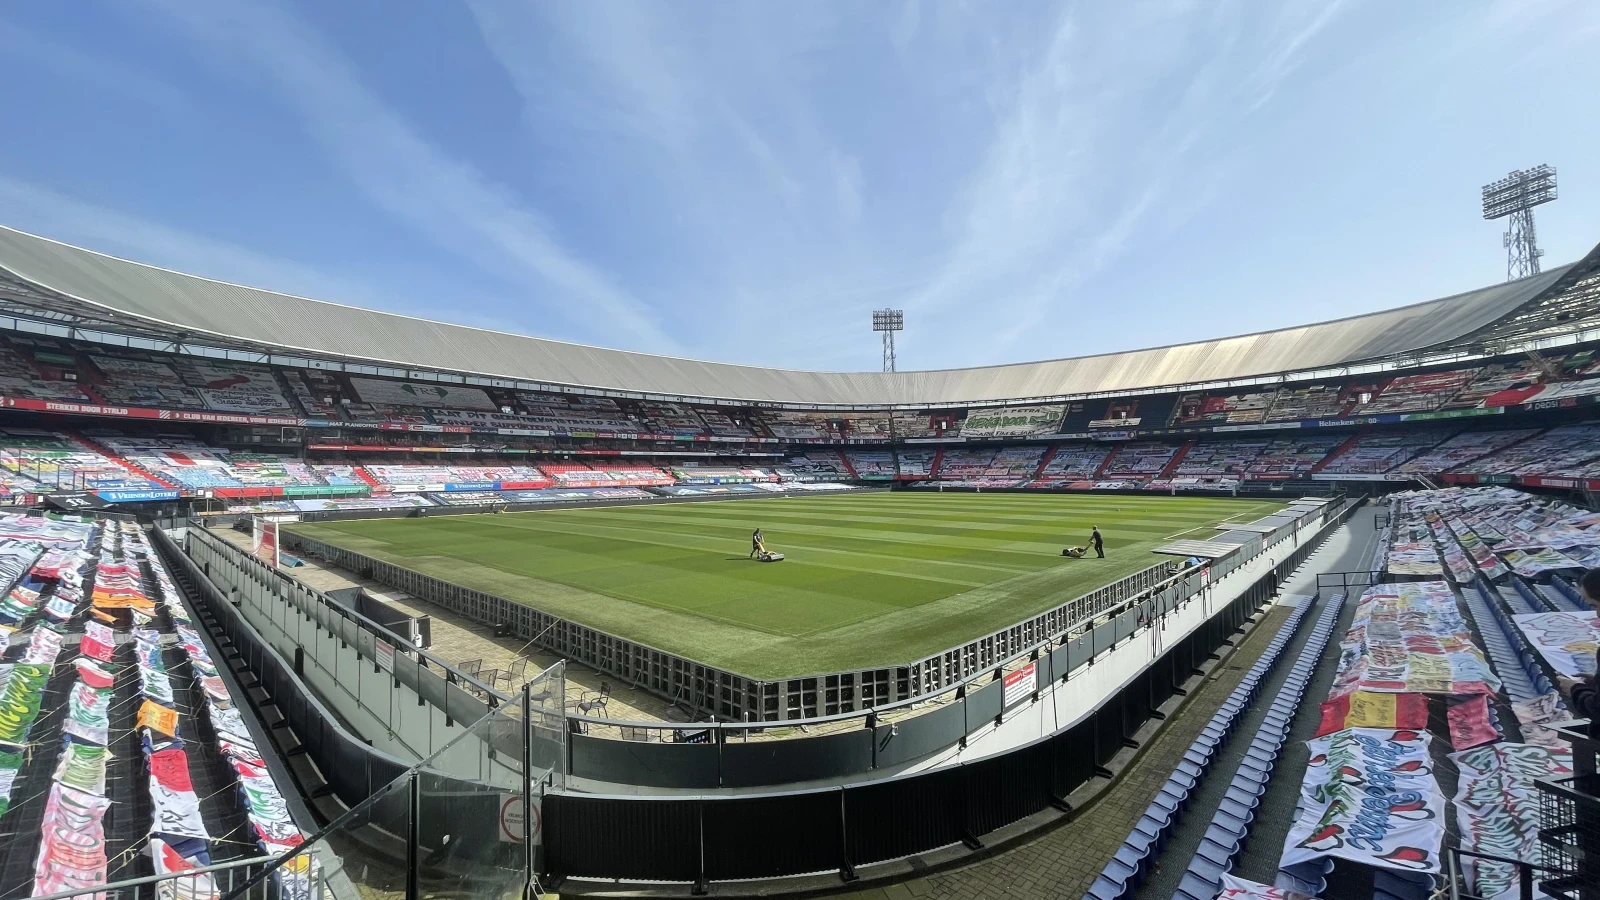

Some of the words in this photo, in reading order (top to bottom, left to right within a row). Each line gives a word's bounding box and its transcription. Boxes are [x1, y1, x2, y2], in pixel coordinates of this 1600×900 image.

[46, 402, 79, 412] STERKER
[81, 405, 101, 413] DOOR
[103, 407, 128, 415] STRIJD
[1534, 401, 1558, 411] pepsi
[183, 412, 201, 420] CLUB
[437, 417, 488, 427] ZONDER
